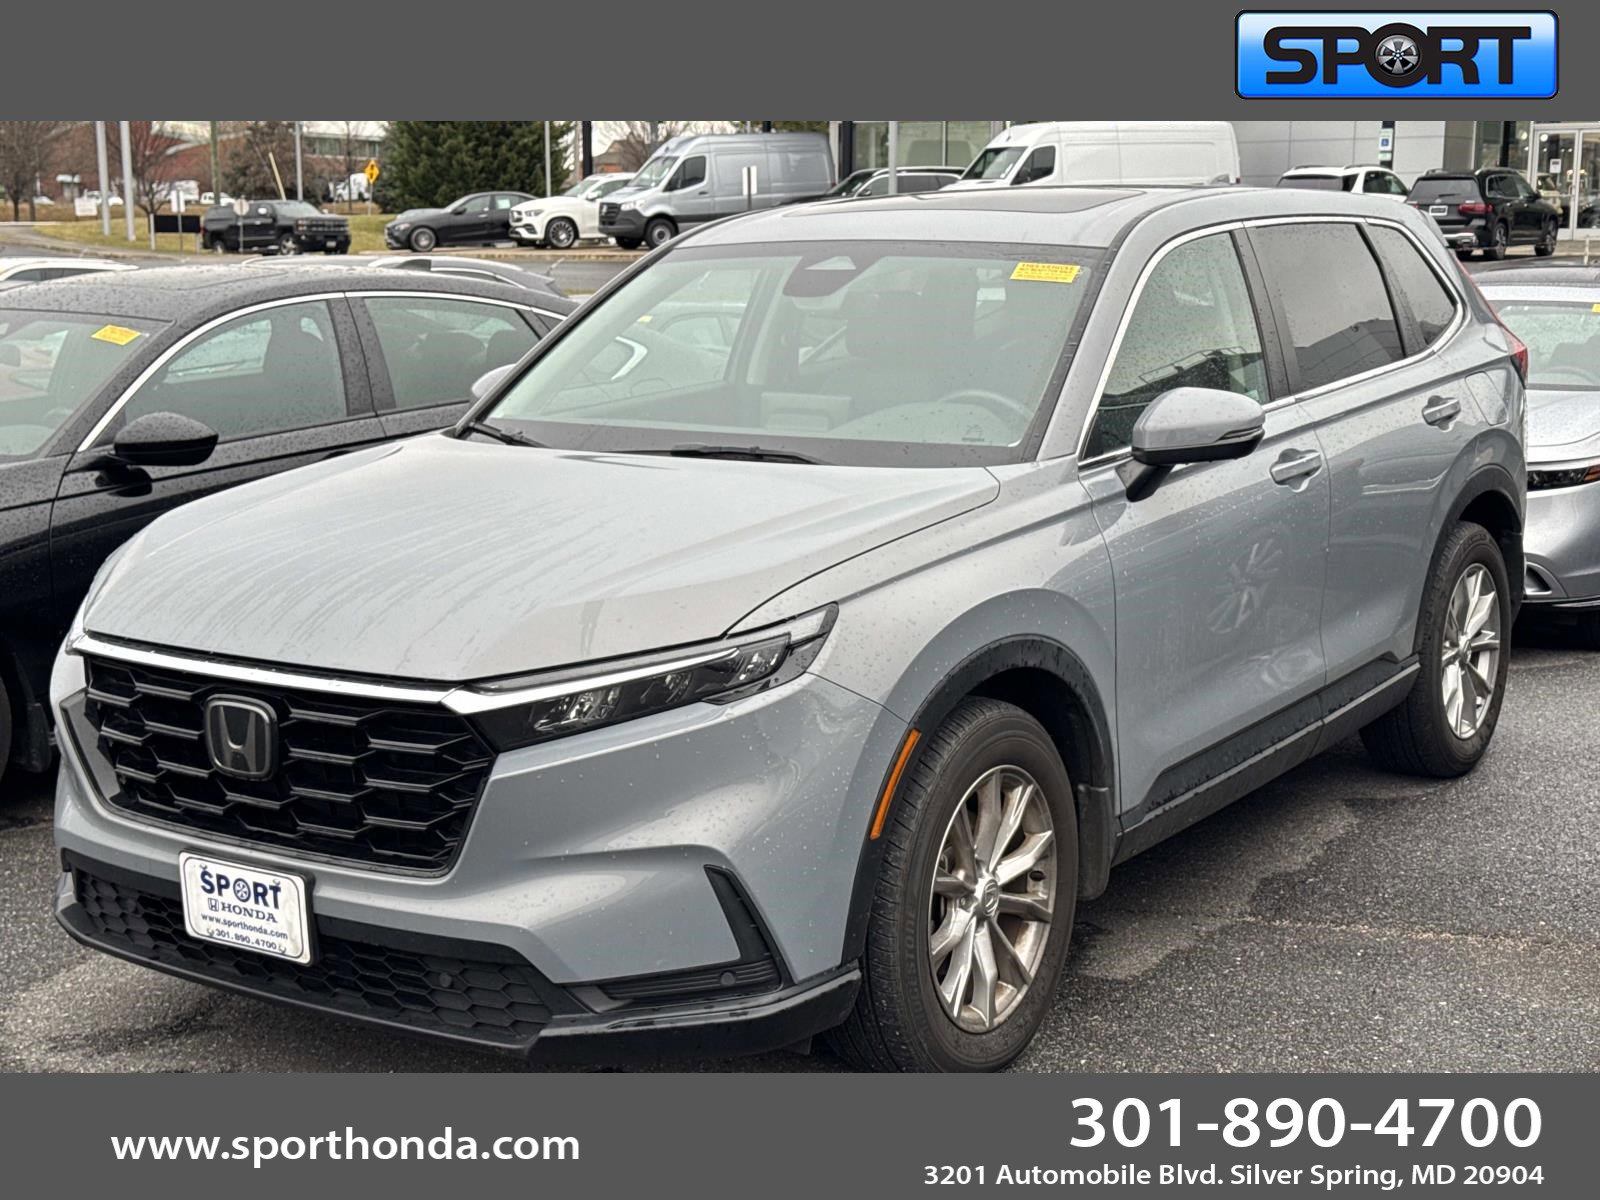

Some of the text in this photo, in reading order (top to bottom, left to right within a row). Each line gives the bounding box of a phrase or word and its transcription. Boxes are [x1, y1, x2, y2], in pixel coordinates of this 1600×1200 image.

[200, 870, 282, 909] SPORT
[221, 902, 278, 923] HONDA
[201, 913, 289, 940] www.sporthonda.com
[215, 929, 277, 950] 301.890.4700
